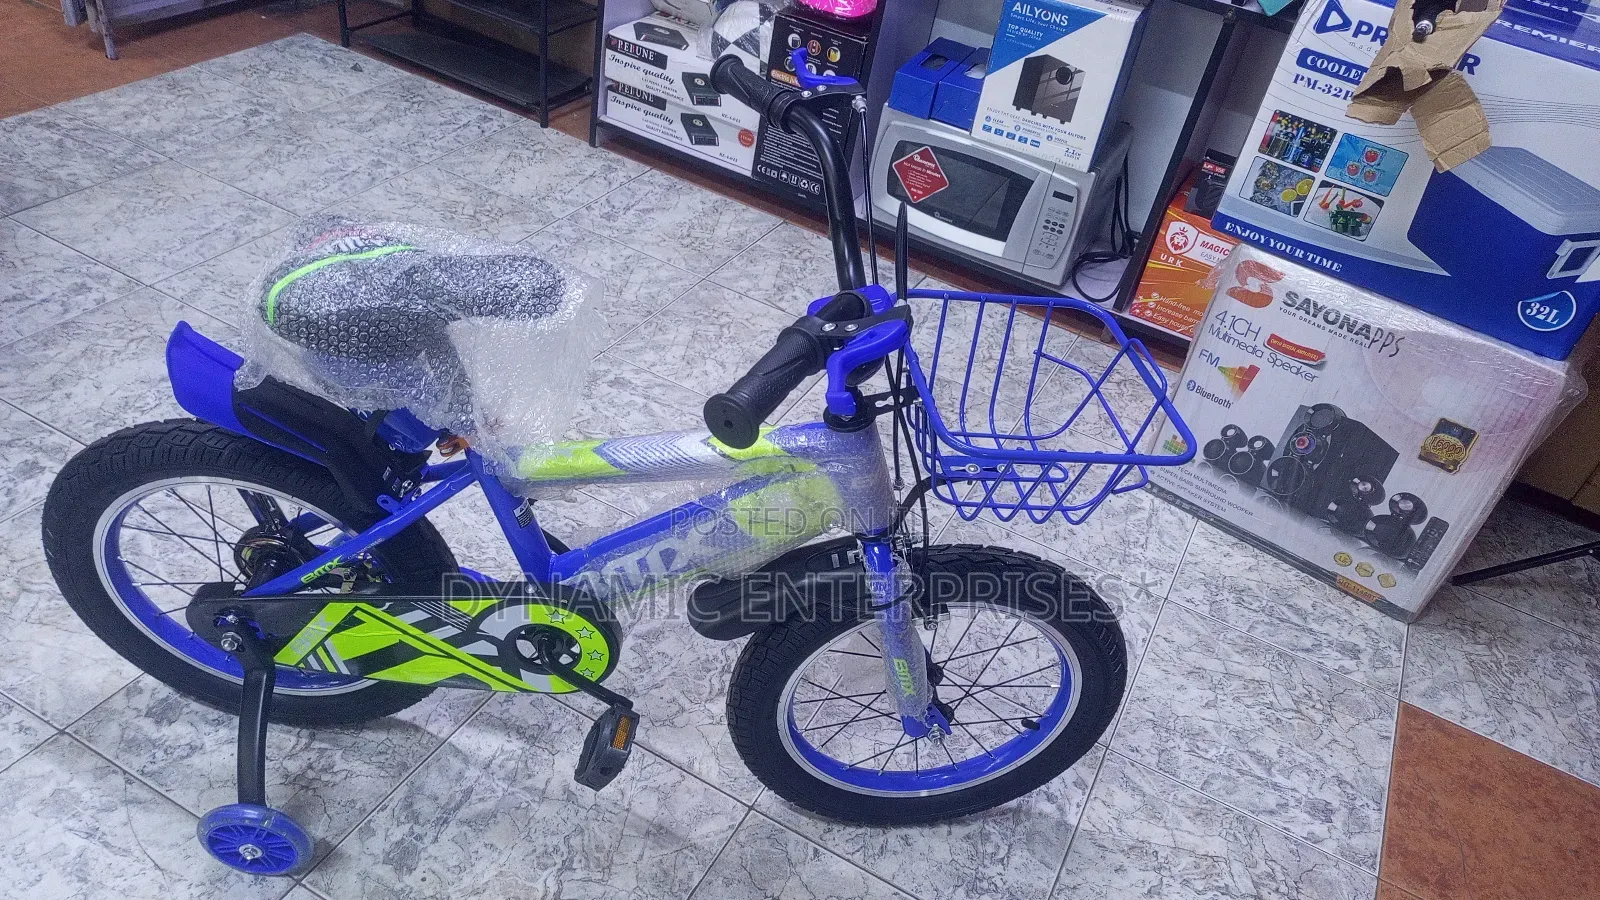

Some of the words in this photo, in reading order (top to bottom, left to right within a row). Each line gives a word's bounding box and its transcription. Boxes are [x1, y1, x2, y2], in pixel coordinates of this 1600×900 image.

[1012, 2, 1068, 26] AILYONS
[1020, 27, 1044, 38] QUALITY
[609, 54, 641, 71] Inspire
[642, 68, 675, 85] quality
[610, 95, 642, 112] Inspire
[643, 109, 674, 125] quality
[1200, 240, 1230, 256] MAGIC
[1200, 251, 1216, 261] EASY
[1224, 221, 1270, 244] ENJOY
[1269, 237, 1305, 258] YOUR
[1306, 252, 1343, 272] TIME
[1160, 253, 1183, 267] URK
[1156, 304, 1183, 319] Increase
[1160, 295, 1191, 312] Hand-free
[1526, 302, 1560, 325] 32L
[1153, 312, 1169, 324] Easy
[1169, 319, 1189, 330] house
[1215, 310, 1262, 342] 4.1CH
[1279, 307, 1297, 318] YOUR
[1298, 317, 1326, 331] DREAMS
[1328, 328, 1348, 340] MADE
[1349, 338, 1368, 348] REAL
[1208, 323, 1264, 359] Multimedia
[1198, 348, 1220, 368] FM
[1266, 352, 1319, 383] Speaker
[1195, 384, 1232, 410] Bluetooth
[1156, 474, 1176, 486] ACTIVE
[1202, 498, 1227, 513] SYSTEM
[1160, 466, 1179, 478] SUPER
[1178, 476, 1194, 487] BASS
[1194, 485, 1227, 504] SURROUND
[1193, 473, 1227, 495] MULTIMEDIA
